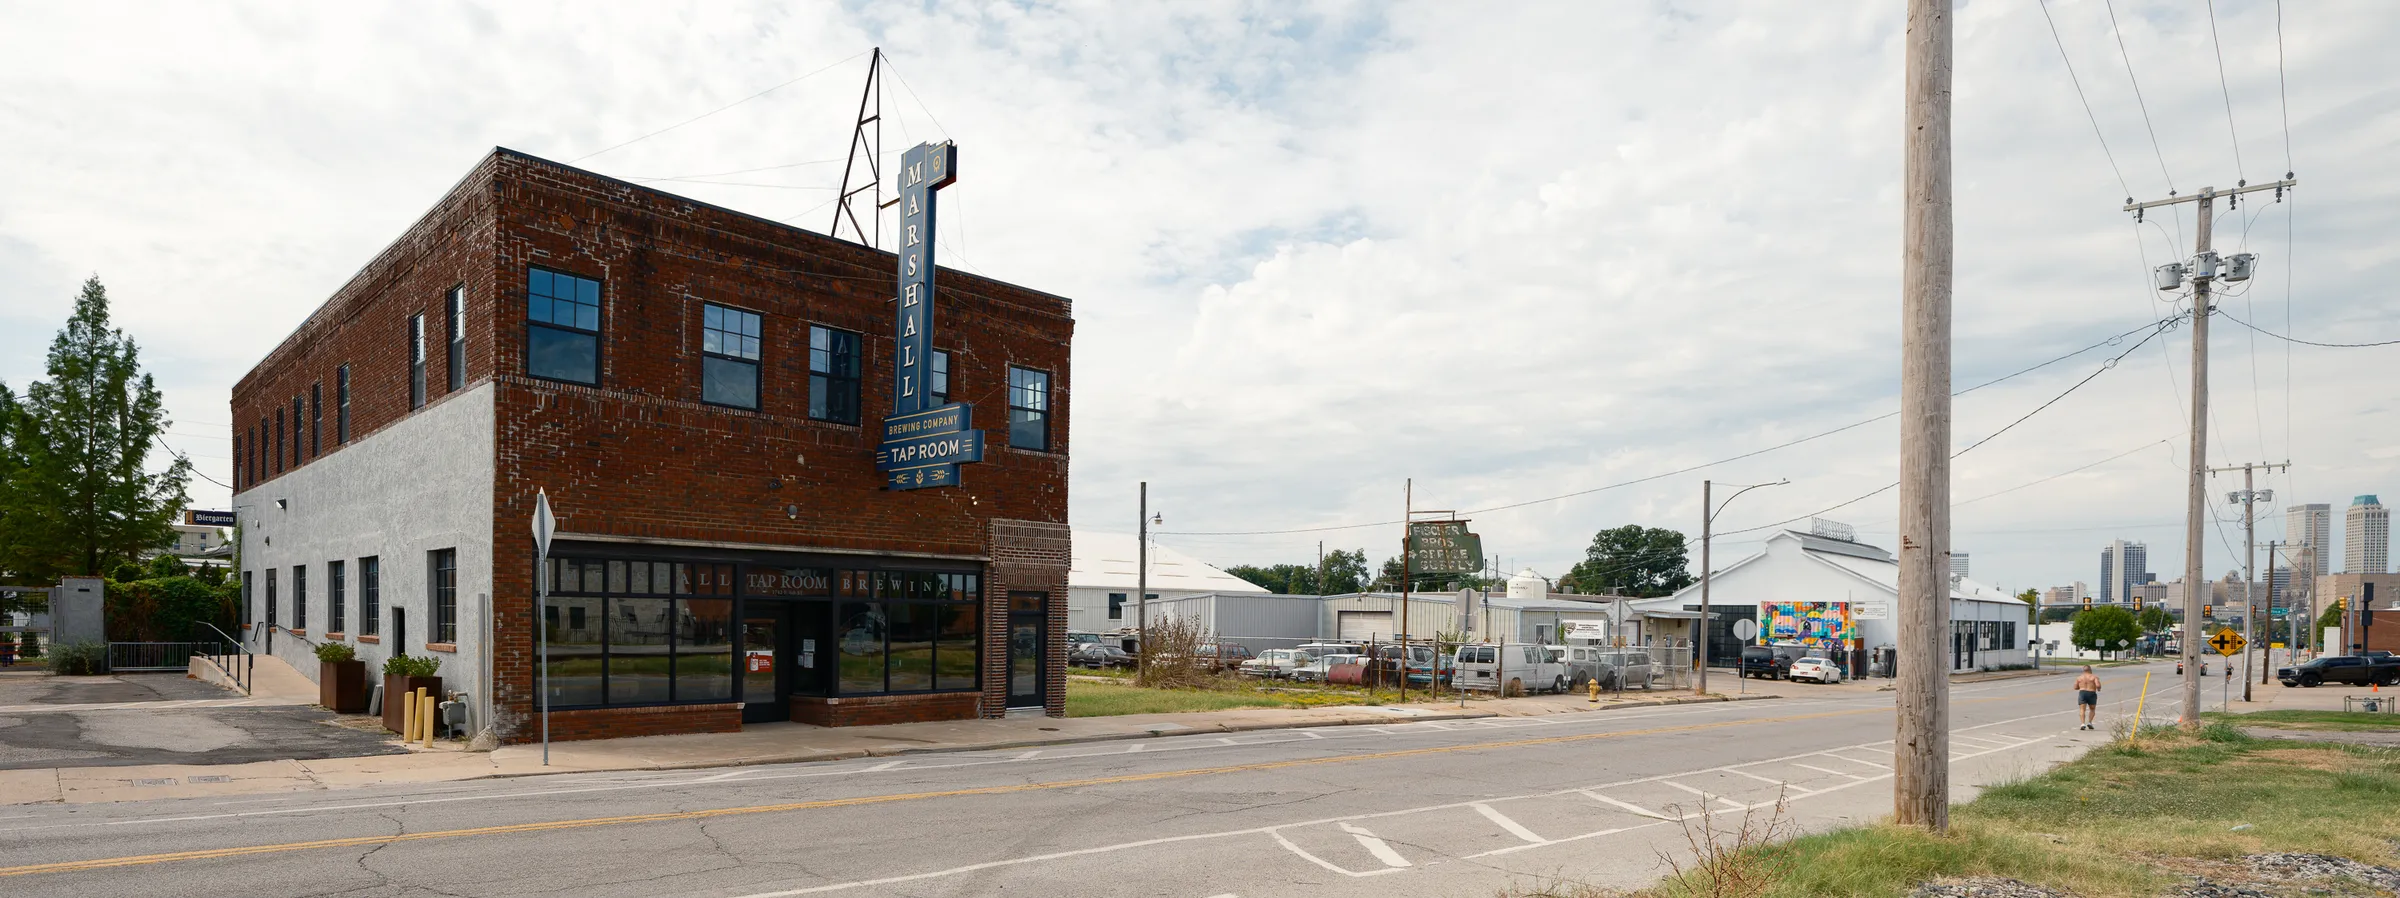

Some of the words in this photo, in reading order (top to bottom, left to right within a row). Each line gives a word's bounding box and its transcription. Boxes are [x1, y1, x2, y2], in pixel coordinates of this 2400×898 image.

[903, 160, 922, 397] MARSHALL
[888, 422, 920, 435] BREWING
[923, 414, 959, 430] COMPANY
[891, 446, 916, 463] TAP
[919, 439, 959, 460] ROOM
[195, 513, 234, 523] Biergarten
[747, 573, 777, 588] TAP
[780, 575, 828, 590] ROOM
[843, 578, 948, 592] BREWING
